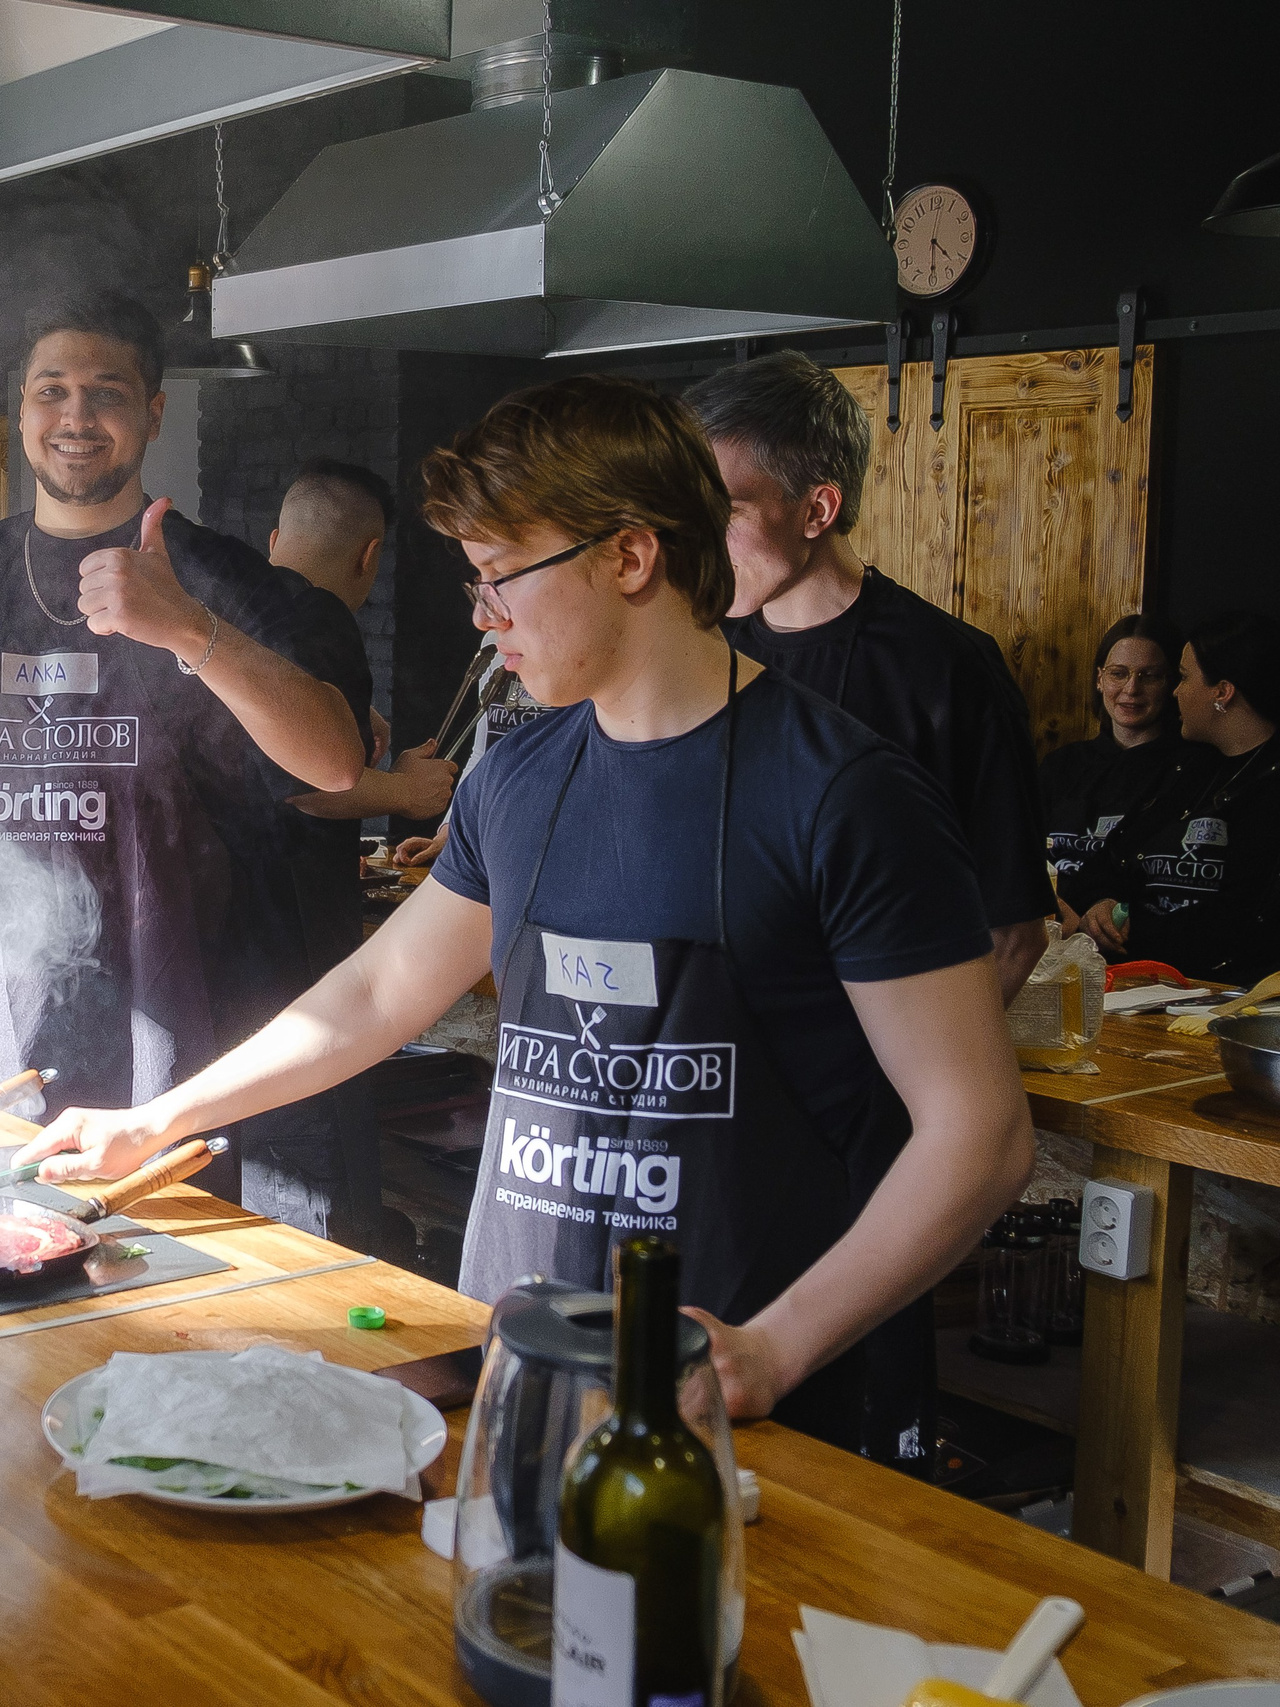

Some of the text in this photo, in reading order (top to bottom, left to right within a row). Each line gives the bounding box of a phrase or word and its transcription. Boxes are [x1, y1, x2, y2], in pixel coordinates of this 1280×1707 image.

[15, 661, 67, 684] АЛКА
[488, 708, 517, 726] ИГРА
[22, 723, 131, 750] СТОЛОВ
[52, 750, 97, 760] СТУДИЯ
[54, 831, 106, 842] техника
[500, 1033, 722, 1092] ИГРА СТОЛОВ
[513, 1076, 668, 1108] КУЛИНАРНАЯ СТУДИЯ
[500, 1117, 680, 1214] körting
[495, 1187, 677, 1231] встраиваемая техника
